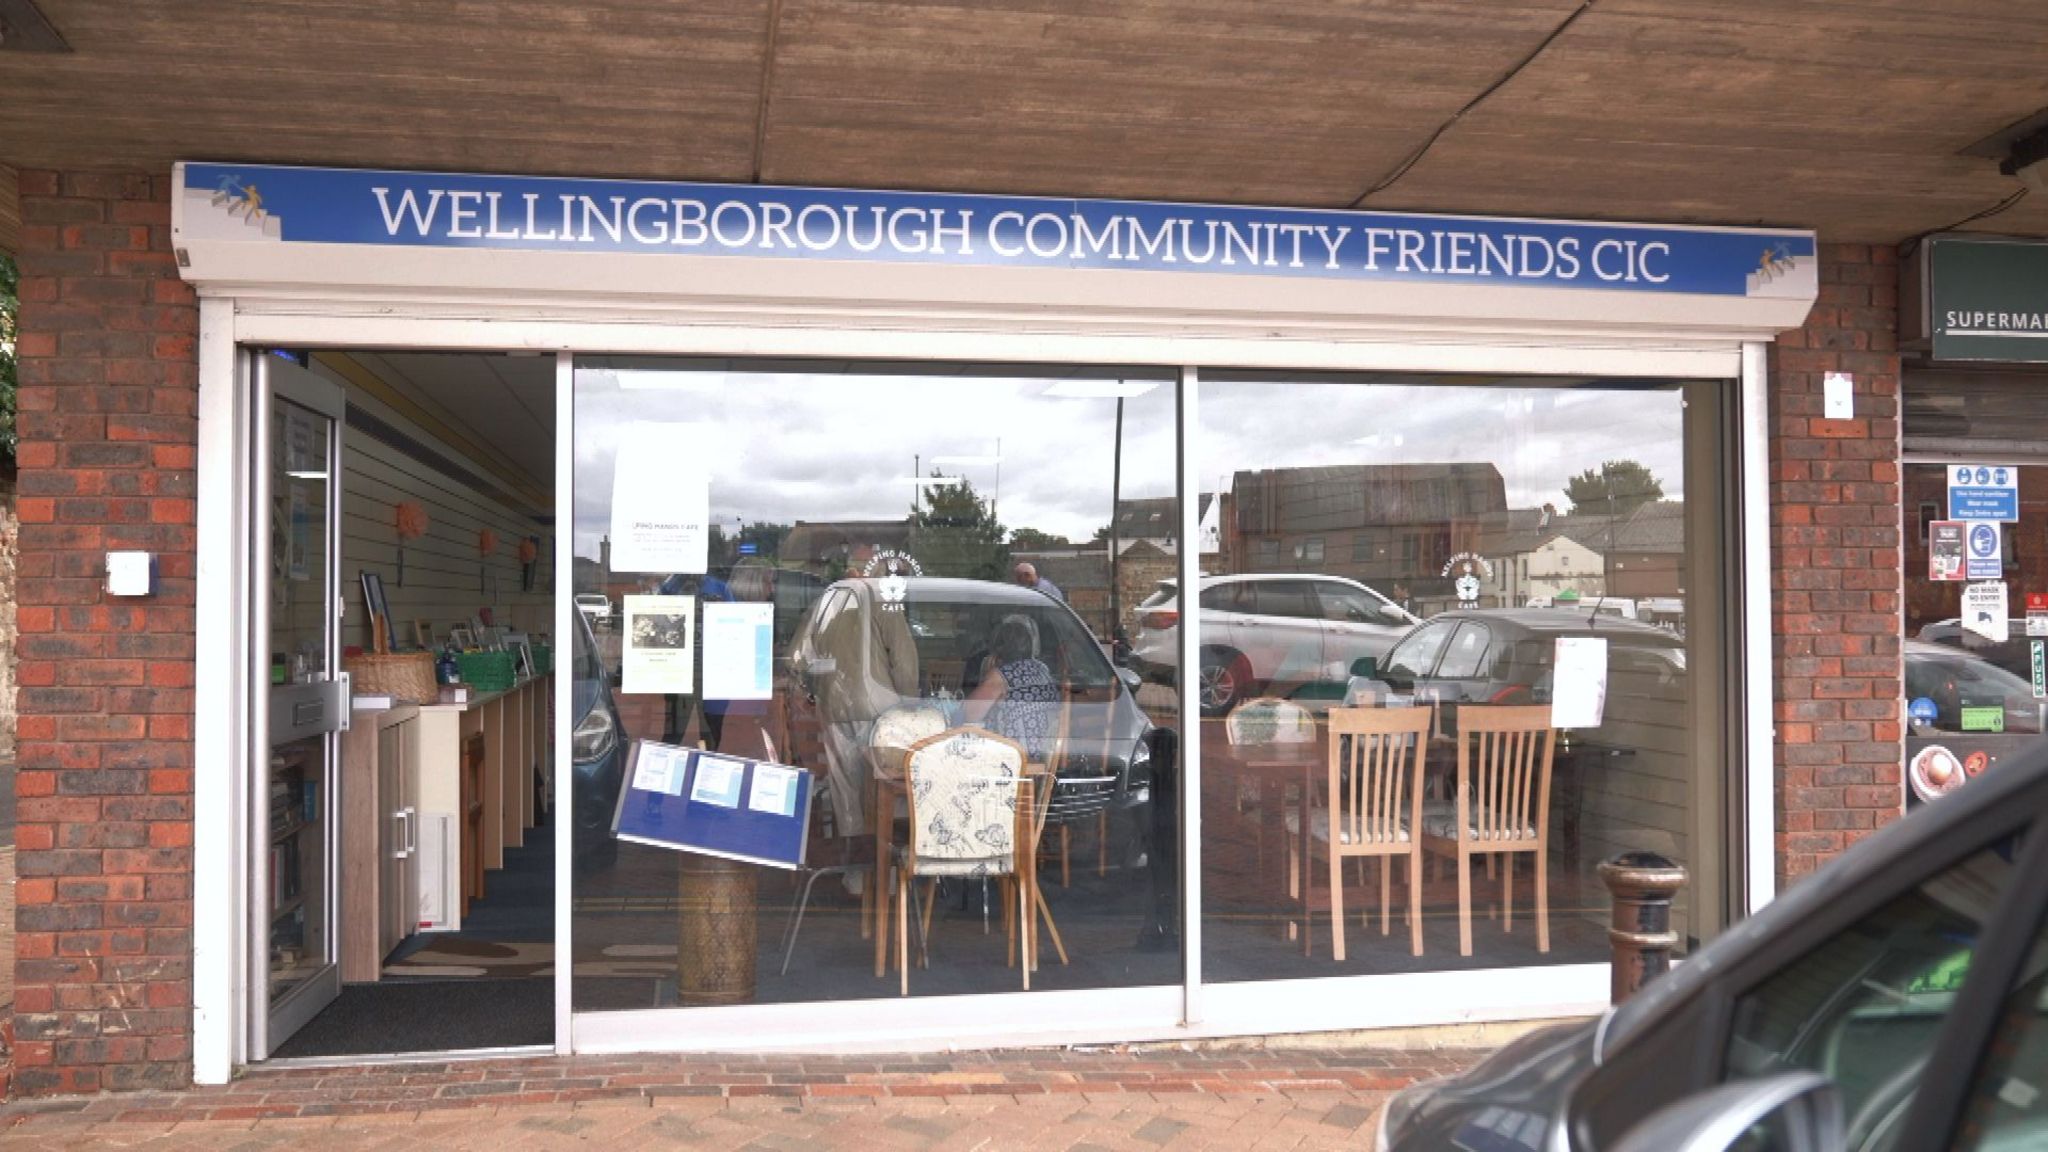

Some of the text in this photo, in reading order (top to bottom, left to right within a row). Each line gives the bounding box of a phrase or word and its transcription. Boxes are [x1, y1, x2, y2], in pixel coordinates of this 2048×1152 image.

[371, 187, 1671, 283] WELLINGBOROUGH COMMUNITY FRIENDS CIC
